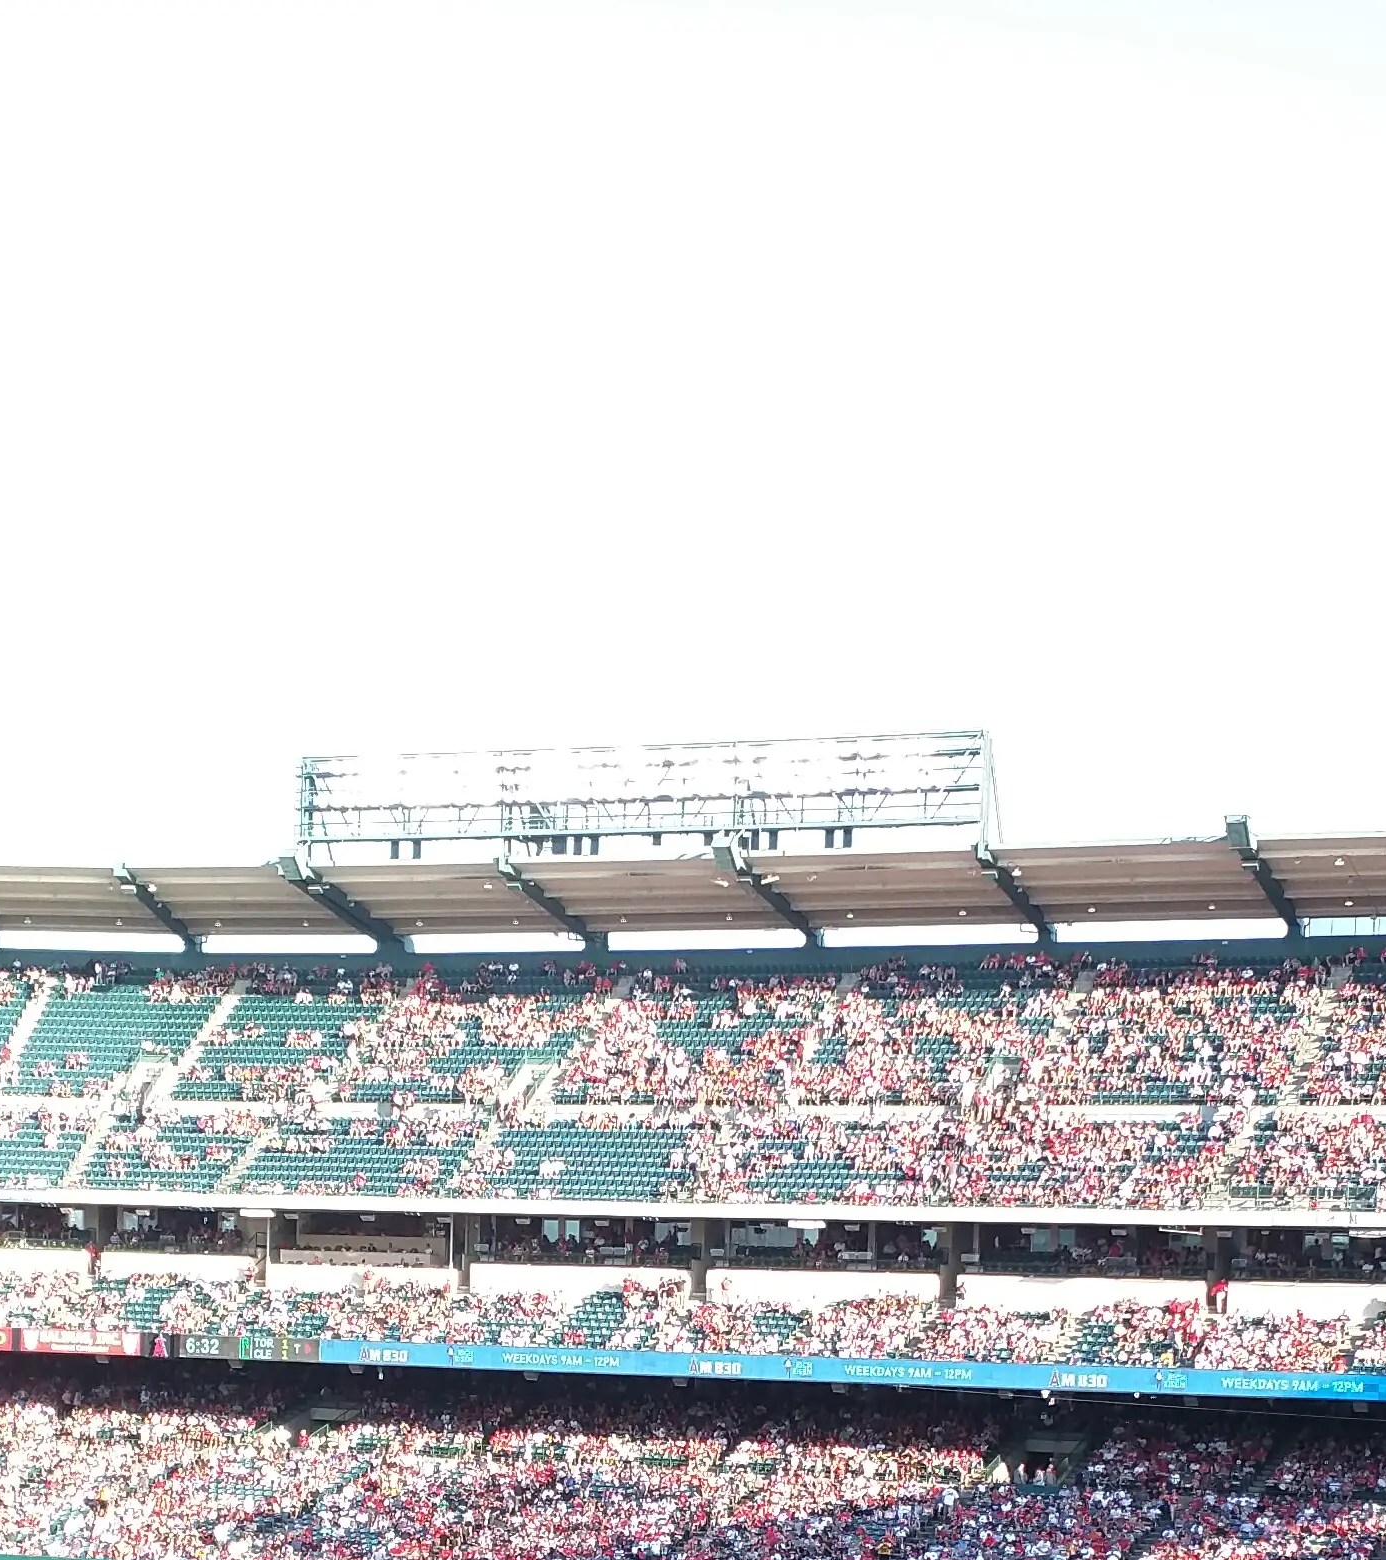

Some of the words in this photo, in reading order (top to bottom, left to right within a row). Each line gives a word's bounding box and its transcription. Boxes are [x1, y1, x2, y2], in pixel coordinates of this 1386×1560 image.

[185, 1338, 219, 1355] 6:32
[254, 1338, 275, 1348] TOR
[281, 1338, 289, 1349] 1
[254, 1350, 273, 1360] CLE
[281, 1350, 289, 1360] 1
[502, 1352, 558, 1365] WEEKDAYS
[560, 1354, 583, 1366] 9AM
[593, 1356, 620, 1368] 12PM
[714, 1360, 742, 1375] 830
[843, 1363, 904, 1377] WEEKDAYS
[907, 1366, 932, 1379] 9AM
[944, 1368, 973, 1381] 12PM
[1220, 1377, 1289, 1391] WEEKDAYS
[1291, 1380, 1319, 1392] 9AM
[1332, 1381, 1363, 1393] 12PM
